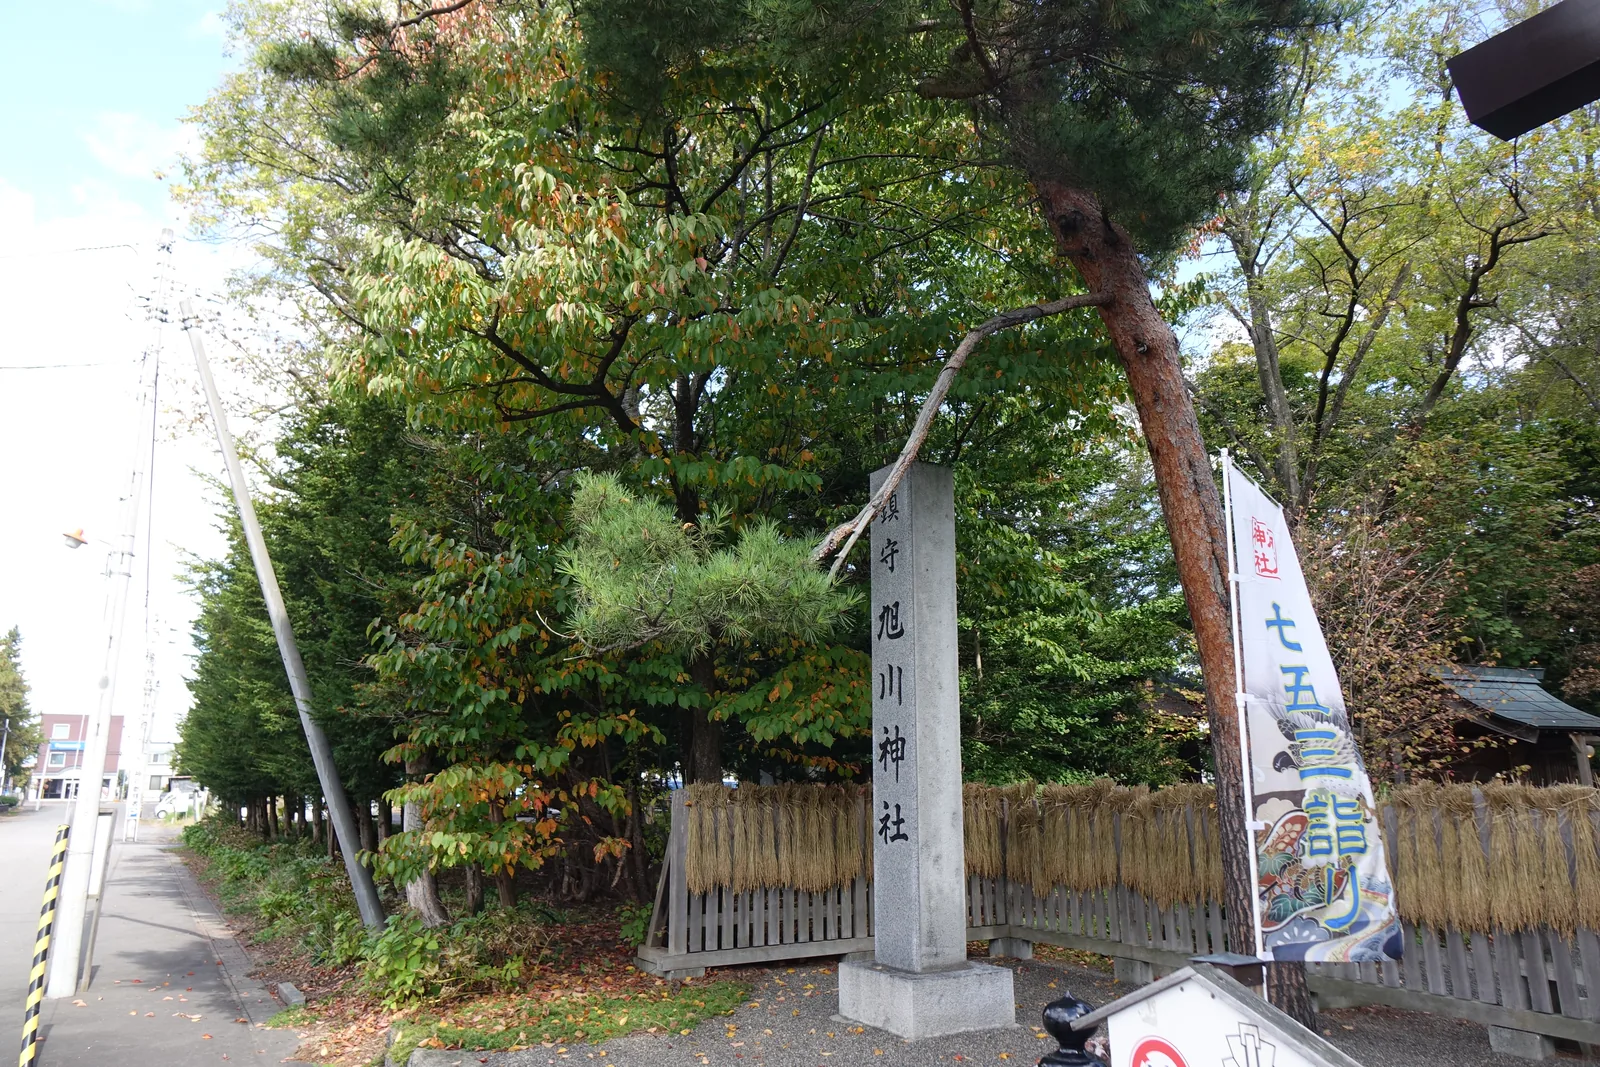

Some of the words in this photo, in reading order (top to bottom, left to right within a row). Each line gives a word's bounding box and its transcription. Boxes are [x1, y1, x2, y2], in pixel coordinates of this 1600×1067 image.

[1264, 601, 1368, 932] 七五三詣り
